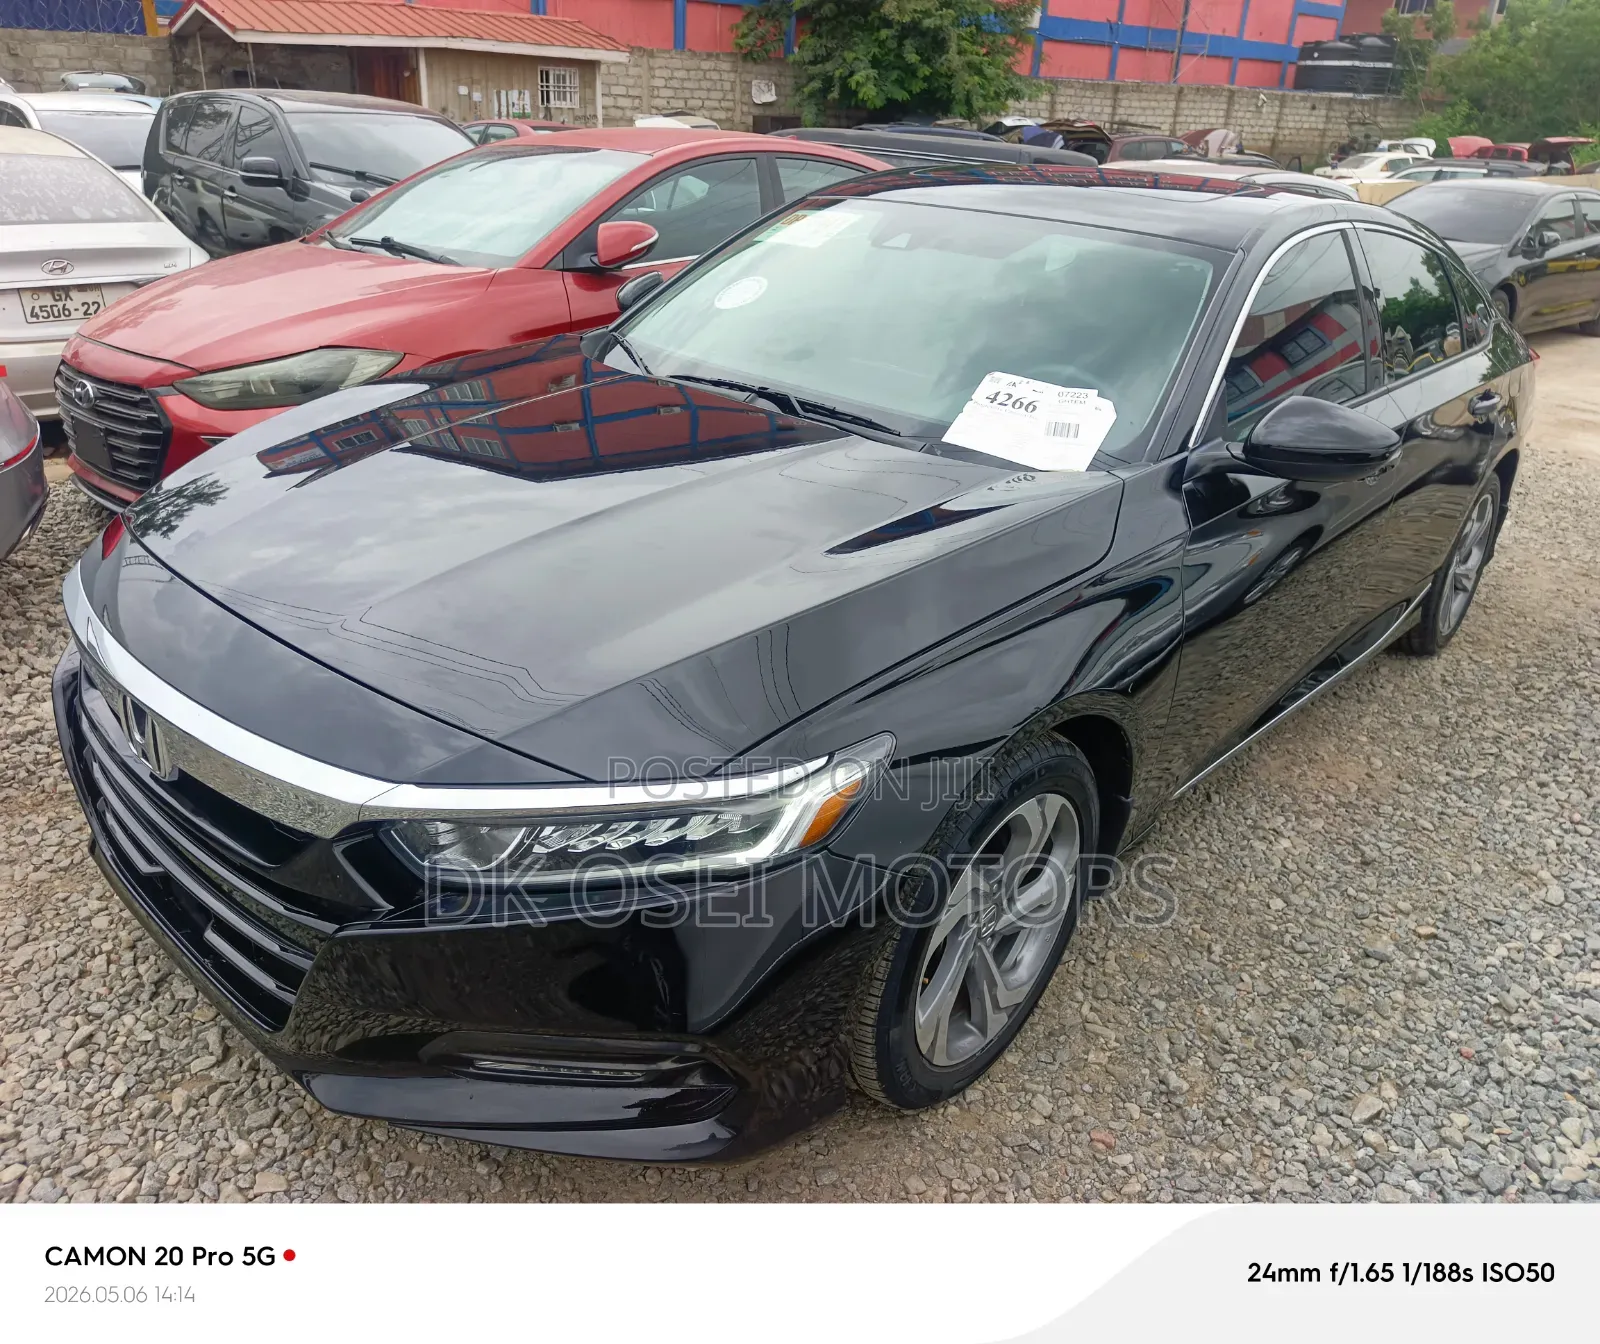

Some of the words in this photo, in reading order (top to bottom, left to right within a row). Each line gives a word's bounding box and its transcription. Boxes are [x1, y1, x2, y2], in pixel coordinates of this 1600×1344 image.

[51, 287, 73, 302] GX
[30, 301, 101, 320] 4506-22
[985, 390, 1038, 414] 4266
[1057, 391, 1089, 399] 07223
